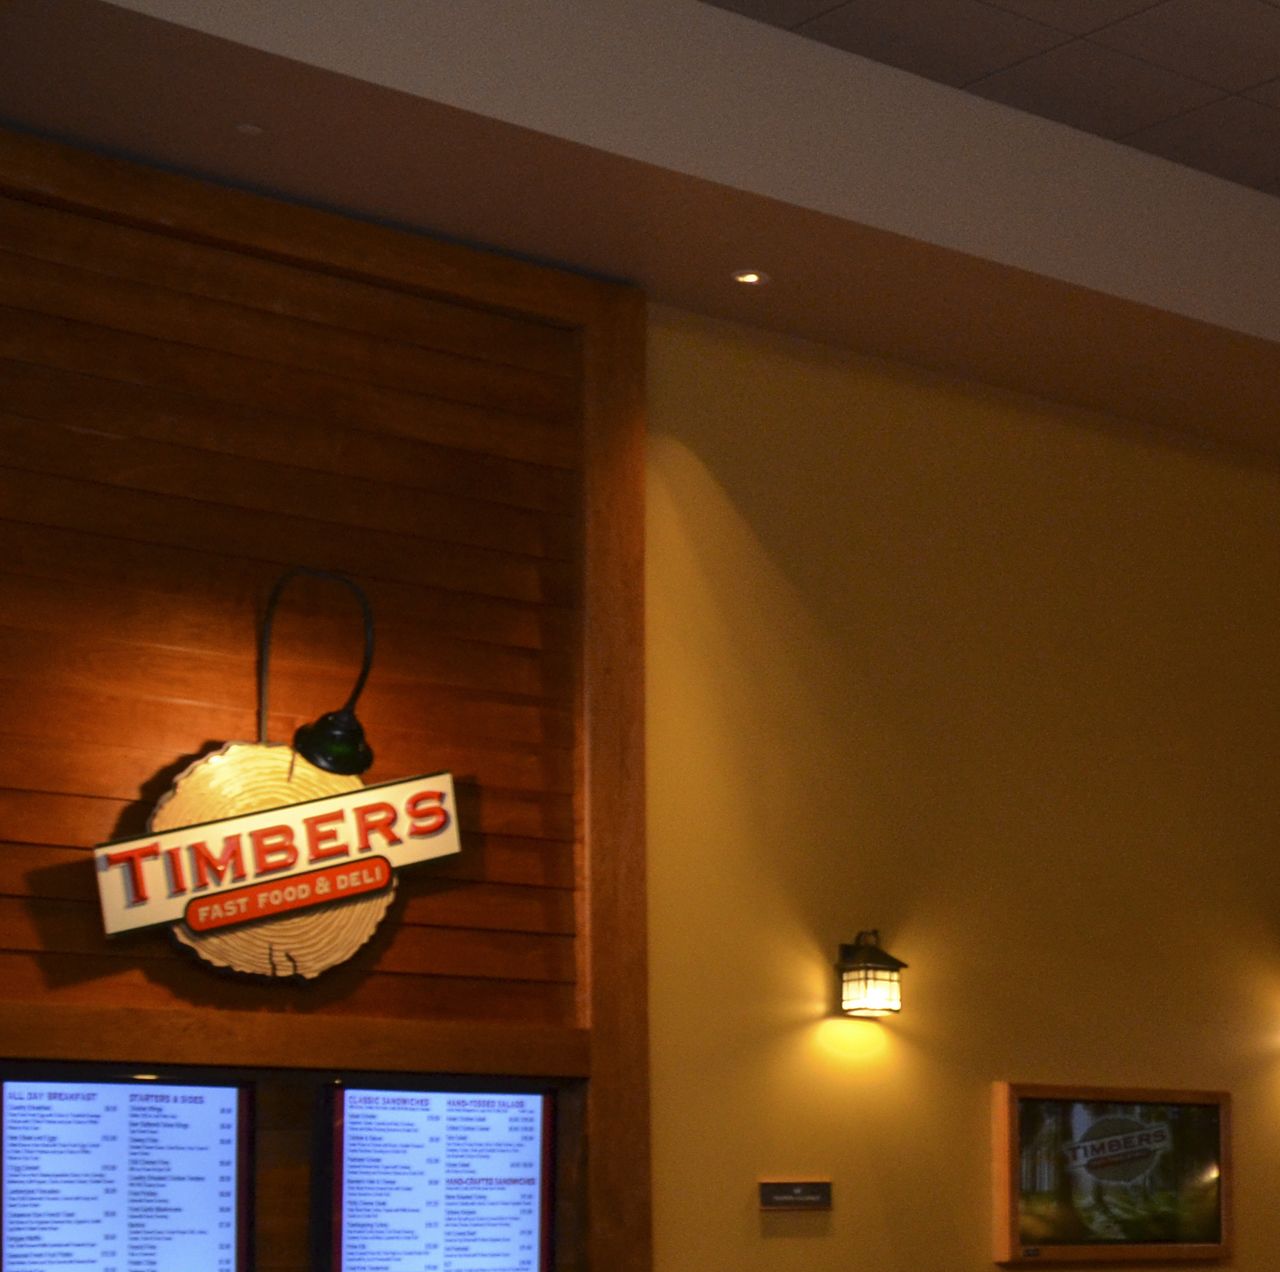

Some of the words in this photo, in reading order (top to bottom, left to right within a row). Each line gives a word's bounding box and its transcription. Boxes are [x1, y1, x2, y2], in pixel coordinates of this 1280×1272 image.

[99, 790, 450, 908] TIMBERS
[198, 897, 248, 923] FAST
[256, 881, 312, 909] FOOD
[315, 877, 331, 896] &
[335, 865, 383, 892] DELI
[1067, 1129, 1168, 1161] TIMBERS
